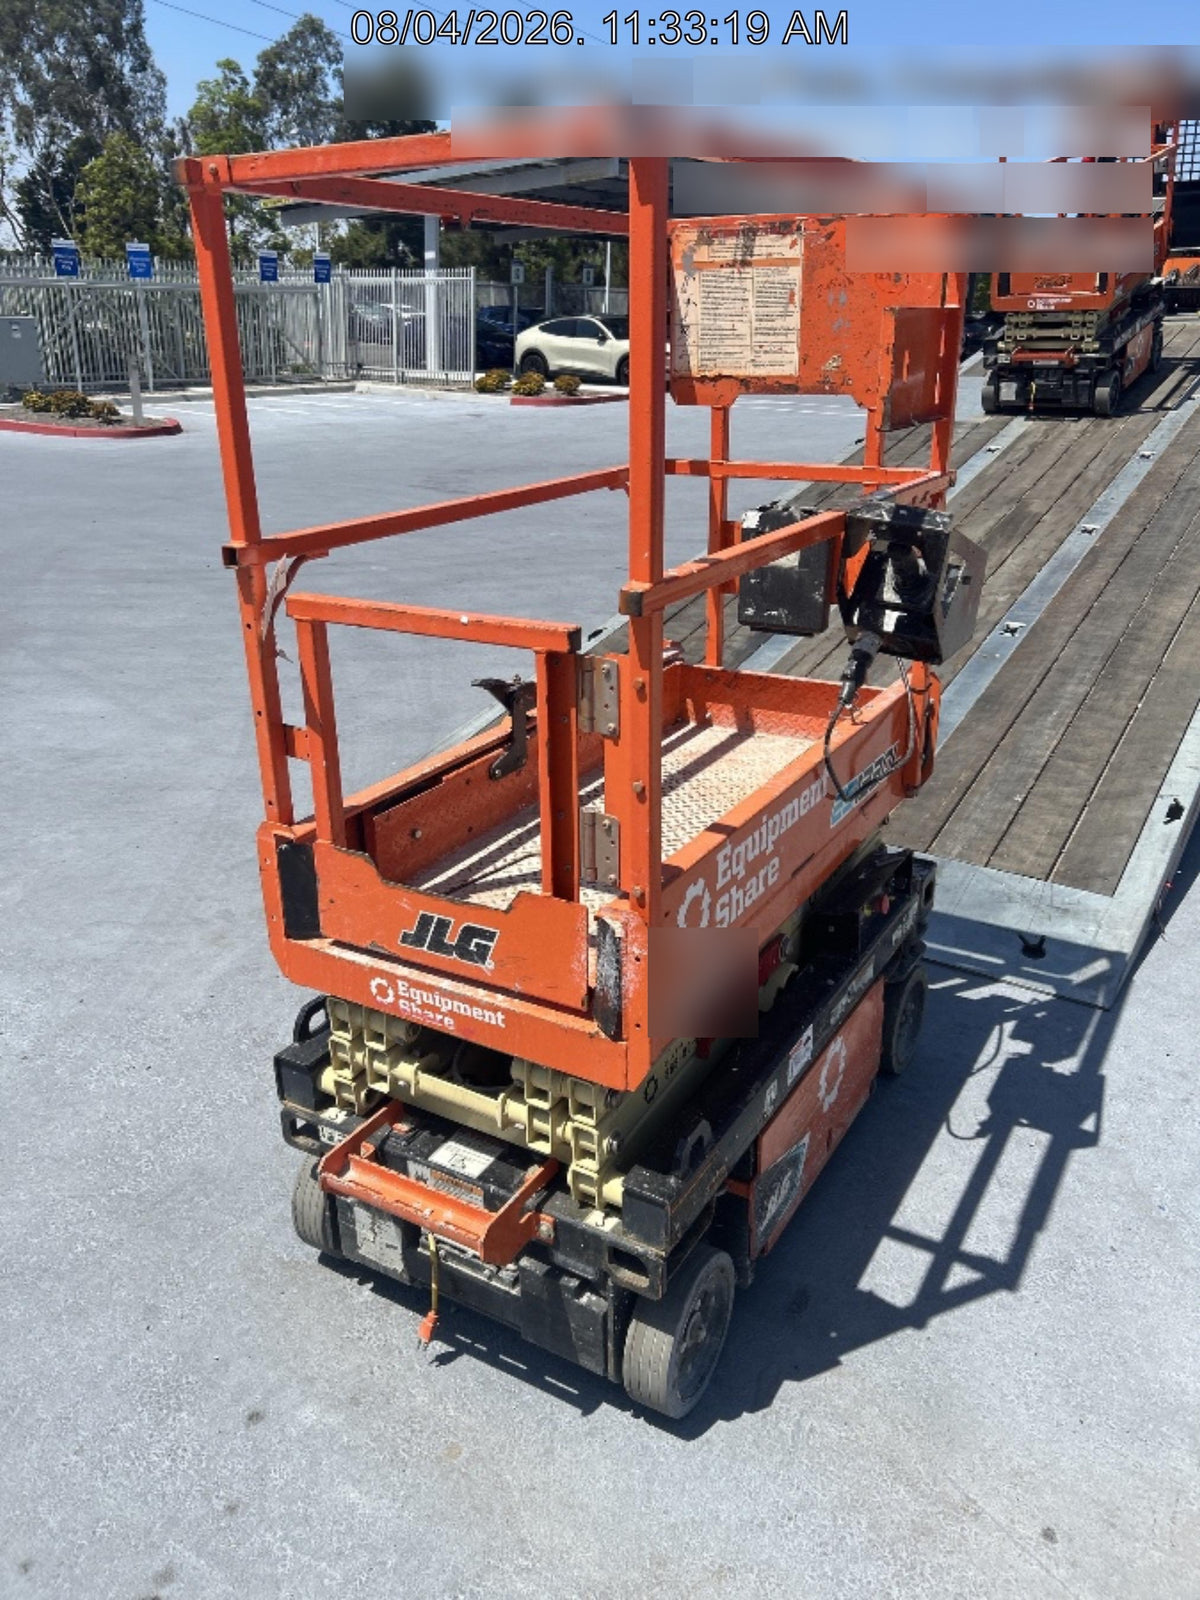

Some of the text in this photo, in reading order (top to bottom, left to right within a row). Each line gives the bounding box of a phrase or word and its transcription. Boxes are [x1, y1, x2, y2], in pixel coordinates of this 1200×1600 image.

[716, 768, 830, 890] Equipment
[715, 856, 780, 928] Share
[398, 910, 500, 968] JLG
[396, 979, 506, 1028] Equipment
[398, 1001, 455, 1031] Share
